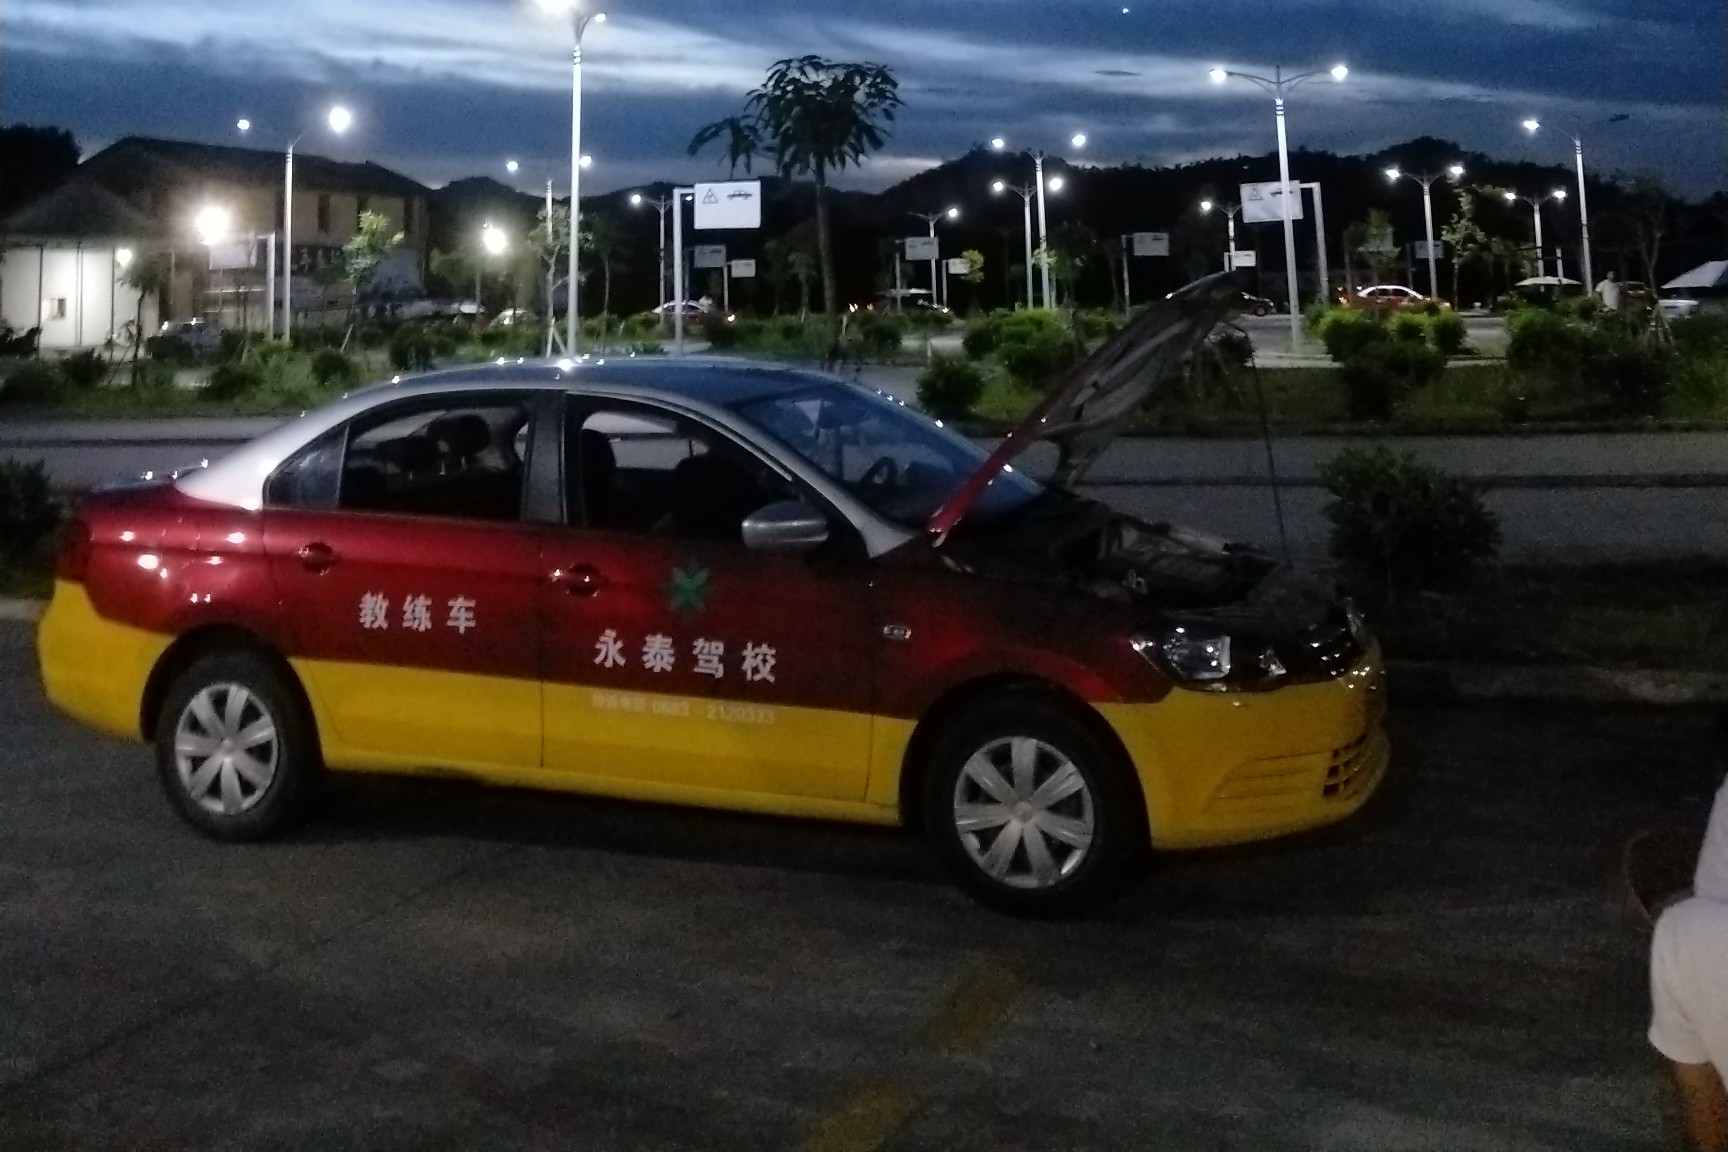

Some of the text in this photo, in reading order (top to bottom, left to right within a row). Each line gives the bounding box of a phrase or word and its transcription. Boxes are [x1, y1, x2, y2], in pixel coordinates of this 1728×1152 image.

[359, 590, 477, 634] 教练车
[594, 628, 776, 684] 永泰驾校
